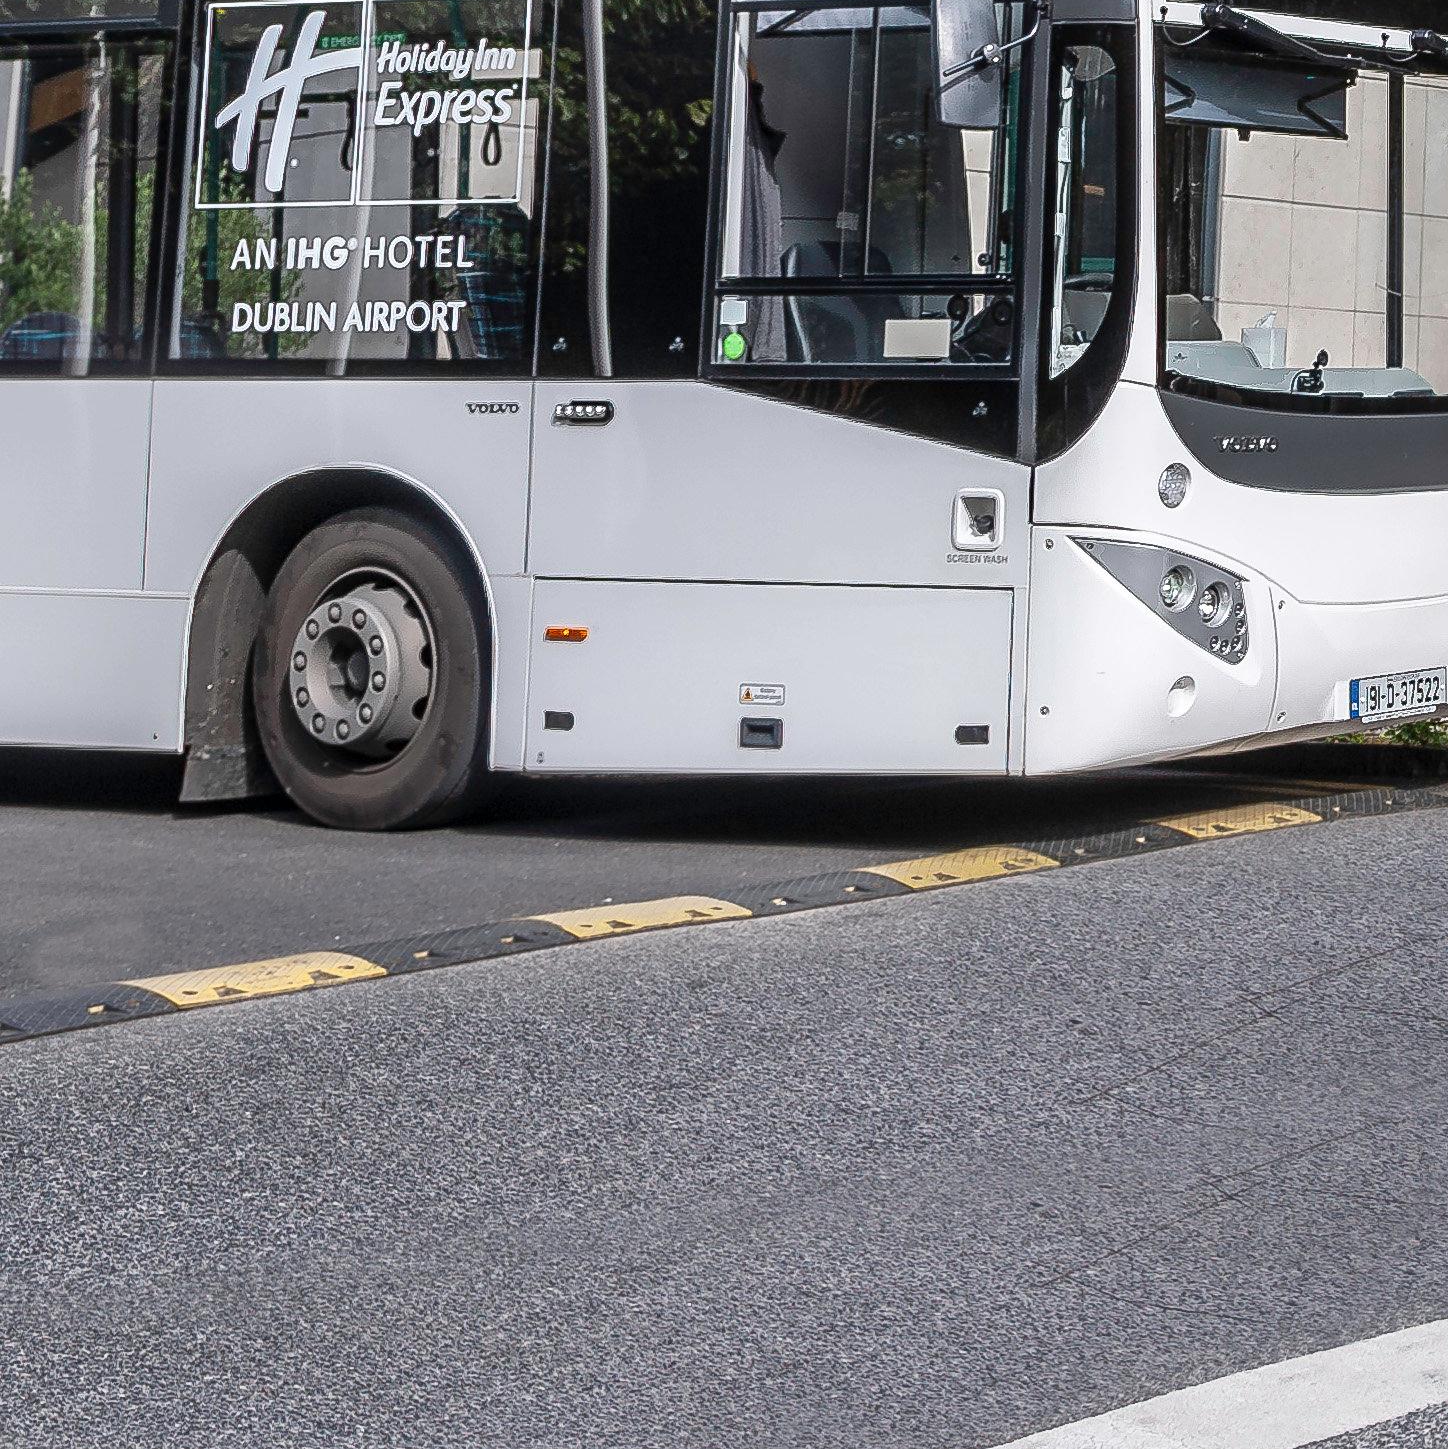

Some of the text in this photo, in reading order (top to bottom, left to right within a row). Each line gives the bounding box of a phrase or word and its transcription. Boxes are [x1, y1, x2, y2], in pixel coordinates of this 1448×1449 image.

[376, 37, 517, 79] Holiday Inn
[373, 81, 516, 137] Express
[229, 237, 278, 270] AN
[362, 235, 475, 270] HOTEL
[231, 300, 468, 333] DUBLIN AIRPORT
[464, 401, 519, 414] VOLVO
[946, 553, 1008, 565] SCREEN WASH
[1365, 675, 1440, 713] 191-D-37522
